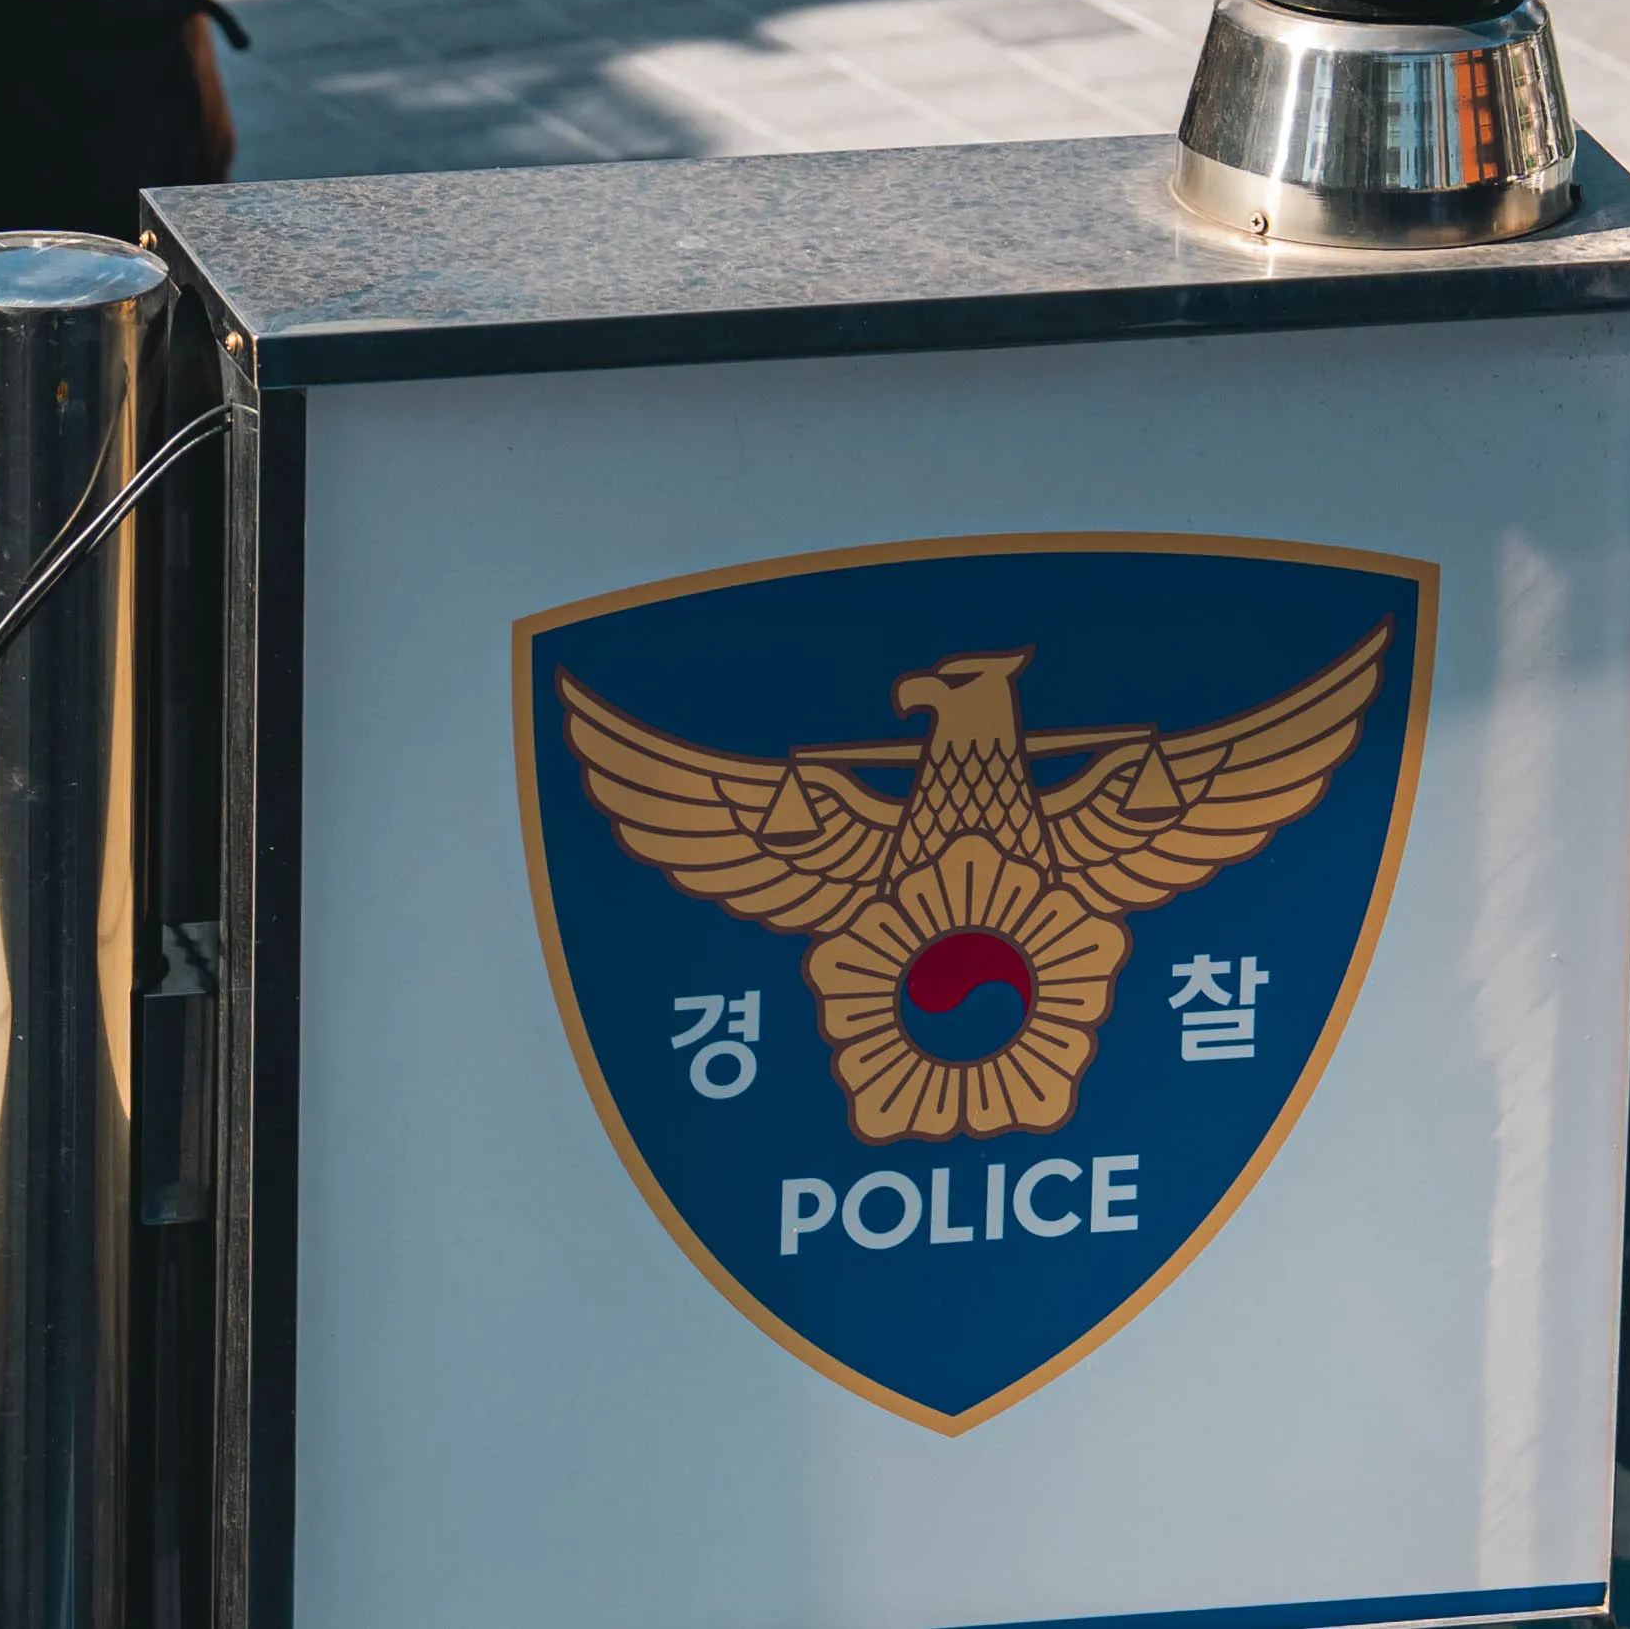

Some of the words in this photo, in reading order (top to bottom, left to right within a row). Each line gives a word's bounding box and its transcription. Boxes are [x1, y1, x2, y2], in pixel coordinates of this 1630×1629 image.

[671, 990, 761, 1100] 경
[1168, 953, 1270, 1063] 찰
[779, 1153, 1140, 1256] POLICE
